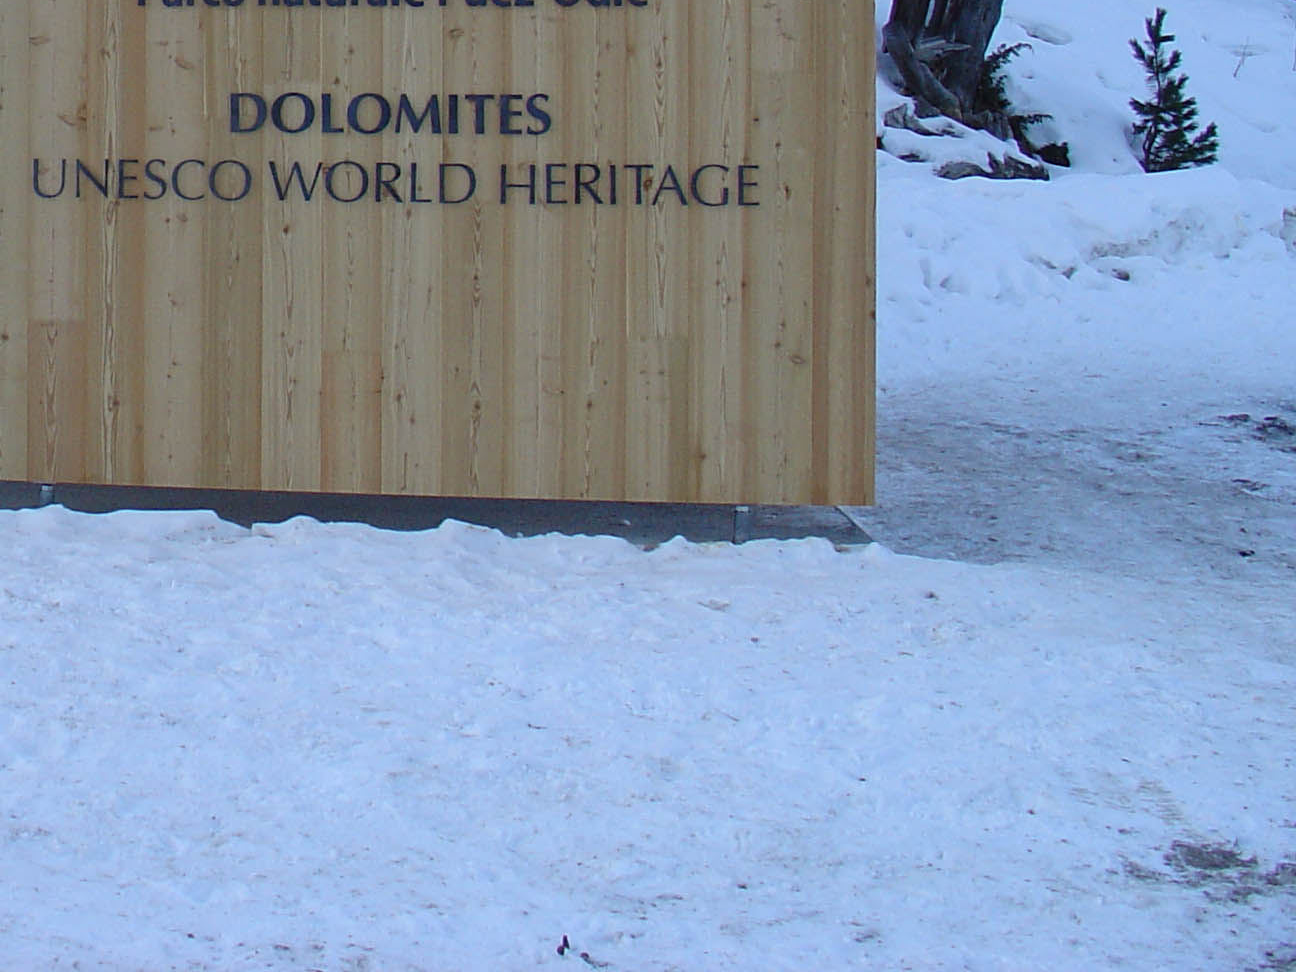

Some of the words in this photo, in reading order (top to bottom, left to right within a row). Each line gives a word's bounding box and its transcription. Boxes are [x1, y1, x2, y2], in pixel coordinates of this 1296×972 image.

[228, 92, 553, 136] DOLOMITES
[32, 158, 253, 203] UNESCO
[268, 160, 477, 205] WORLD
[500, 164, 761, 208] HERITAGE
